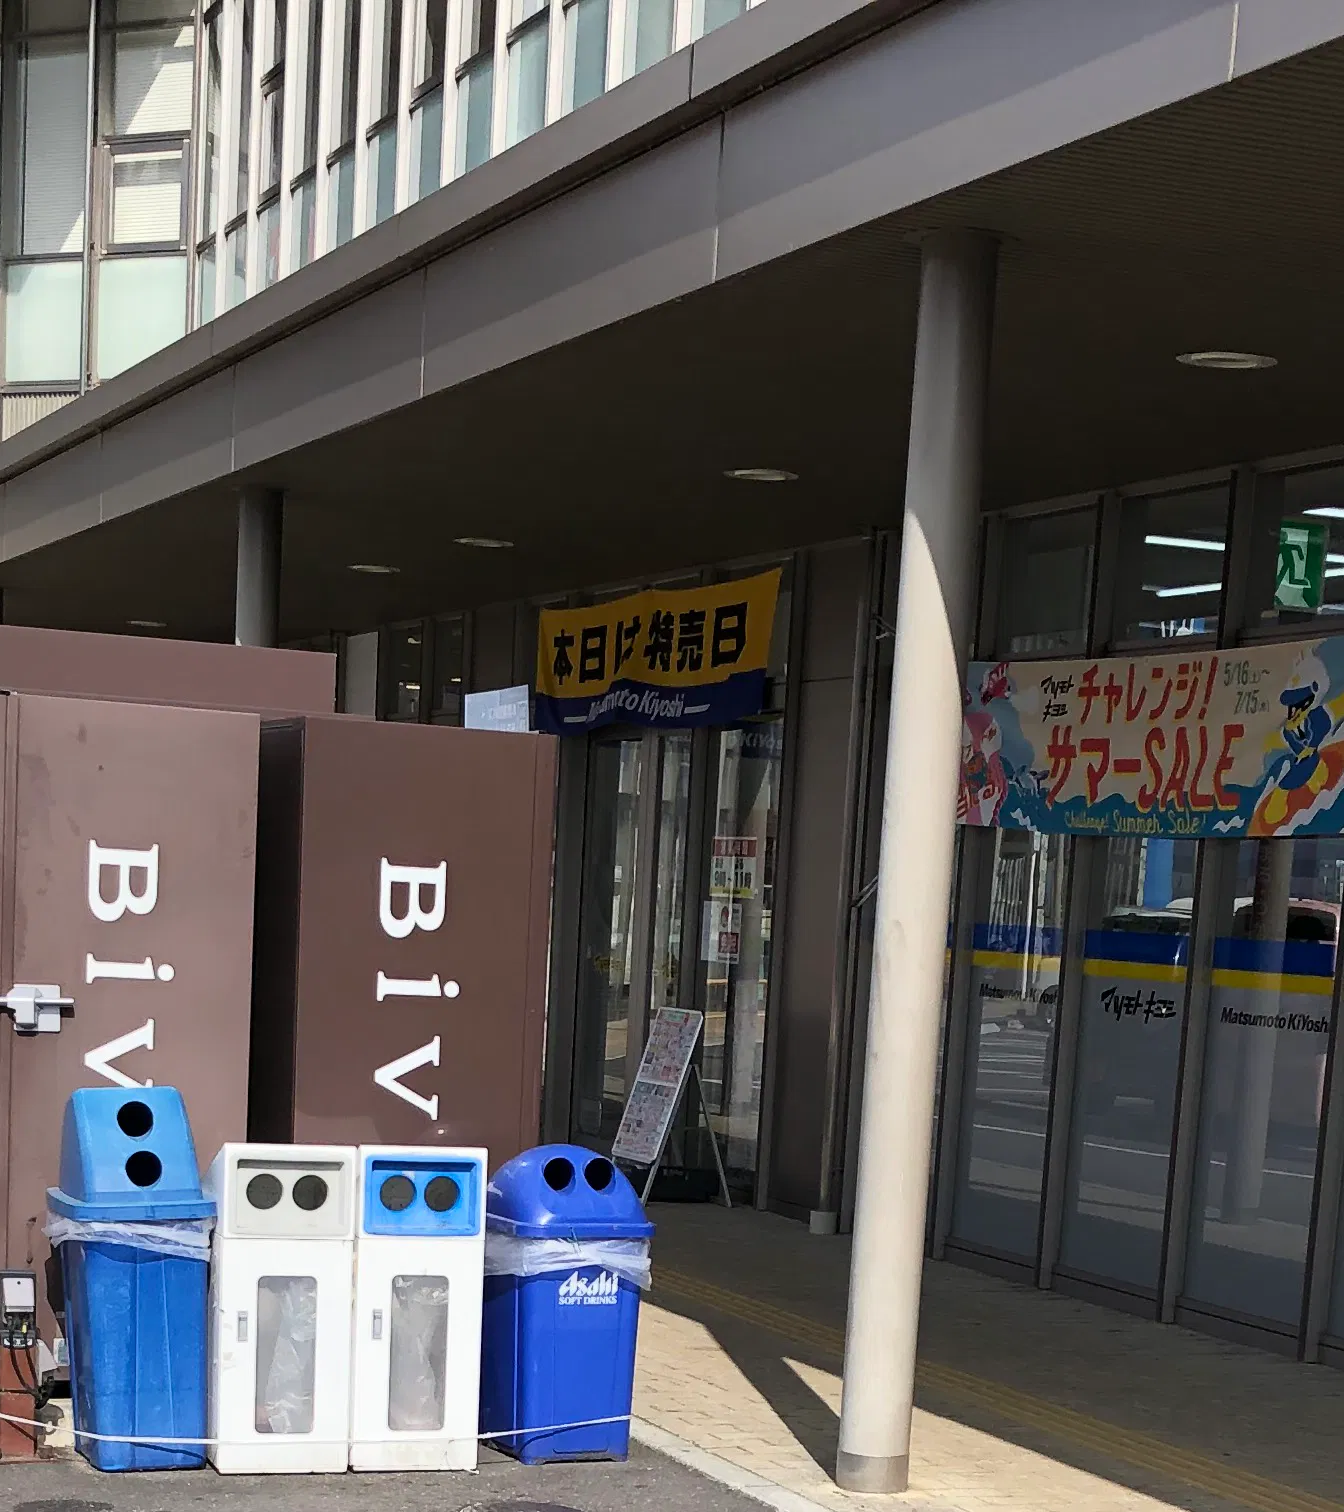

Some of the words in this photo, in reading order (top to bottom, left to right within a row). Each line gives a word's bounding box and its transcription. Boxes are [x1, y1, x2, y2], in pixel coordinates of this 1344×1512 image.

[553, 602, 748, 685] 本日は特売日
[1220, 1006, 1287, 1029] Matsumoto
[1287, 1013, 1329, 1033] KiYosh
[559, 1271, 619, 1296] Asahi
[558, 1296, 582, 1305] SOFT
[583, 1296, 618, 1305] DRINKS
